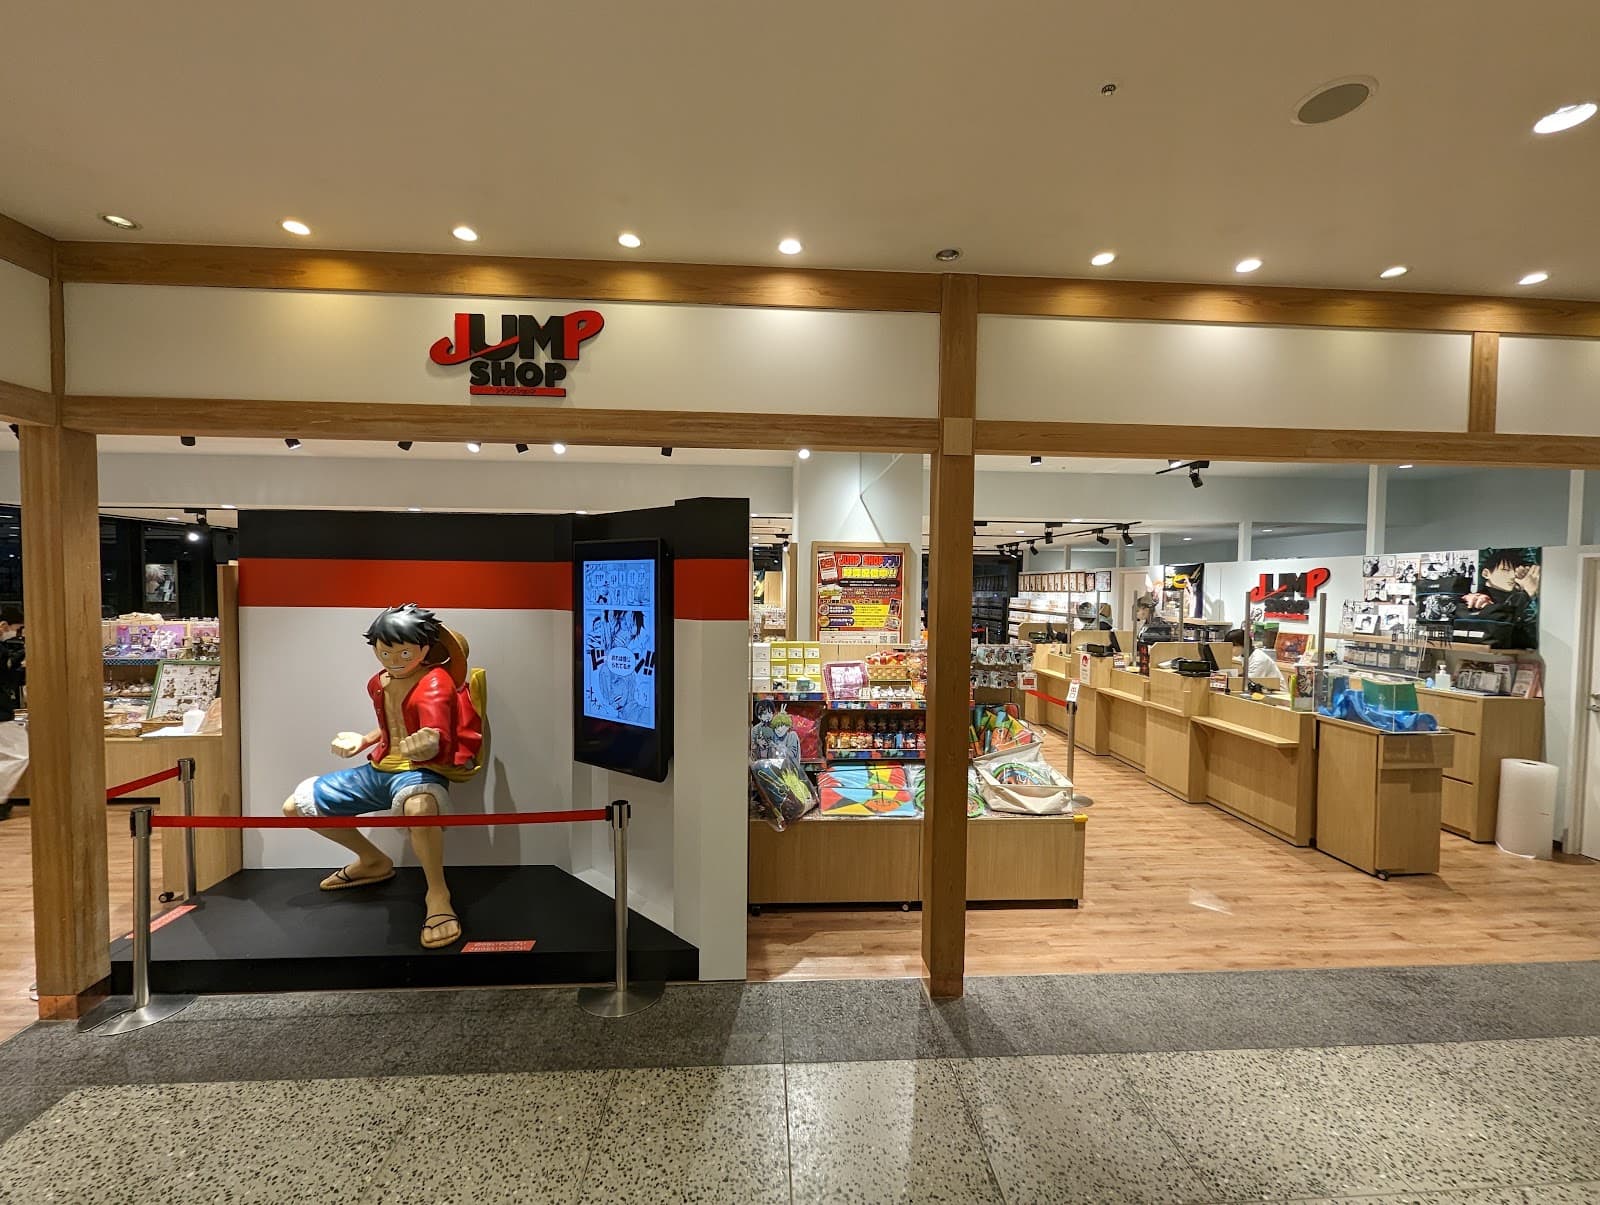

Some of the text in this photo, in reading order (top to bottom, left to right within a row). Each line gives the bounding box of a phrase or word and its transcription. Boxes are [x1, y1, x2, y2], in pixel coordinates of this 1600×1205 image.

[429, 309, 605, 365] JUMP
[469, 360, 567, 388] SHOP
[1250, 567, 1331, 603] JUMP
